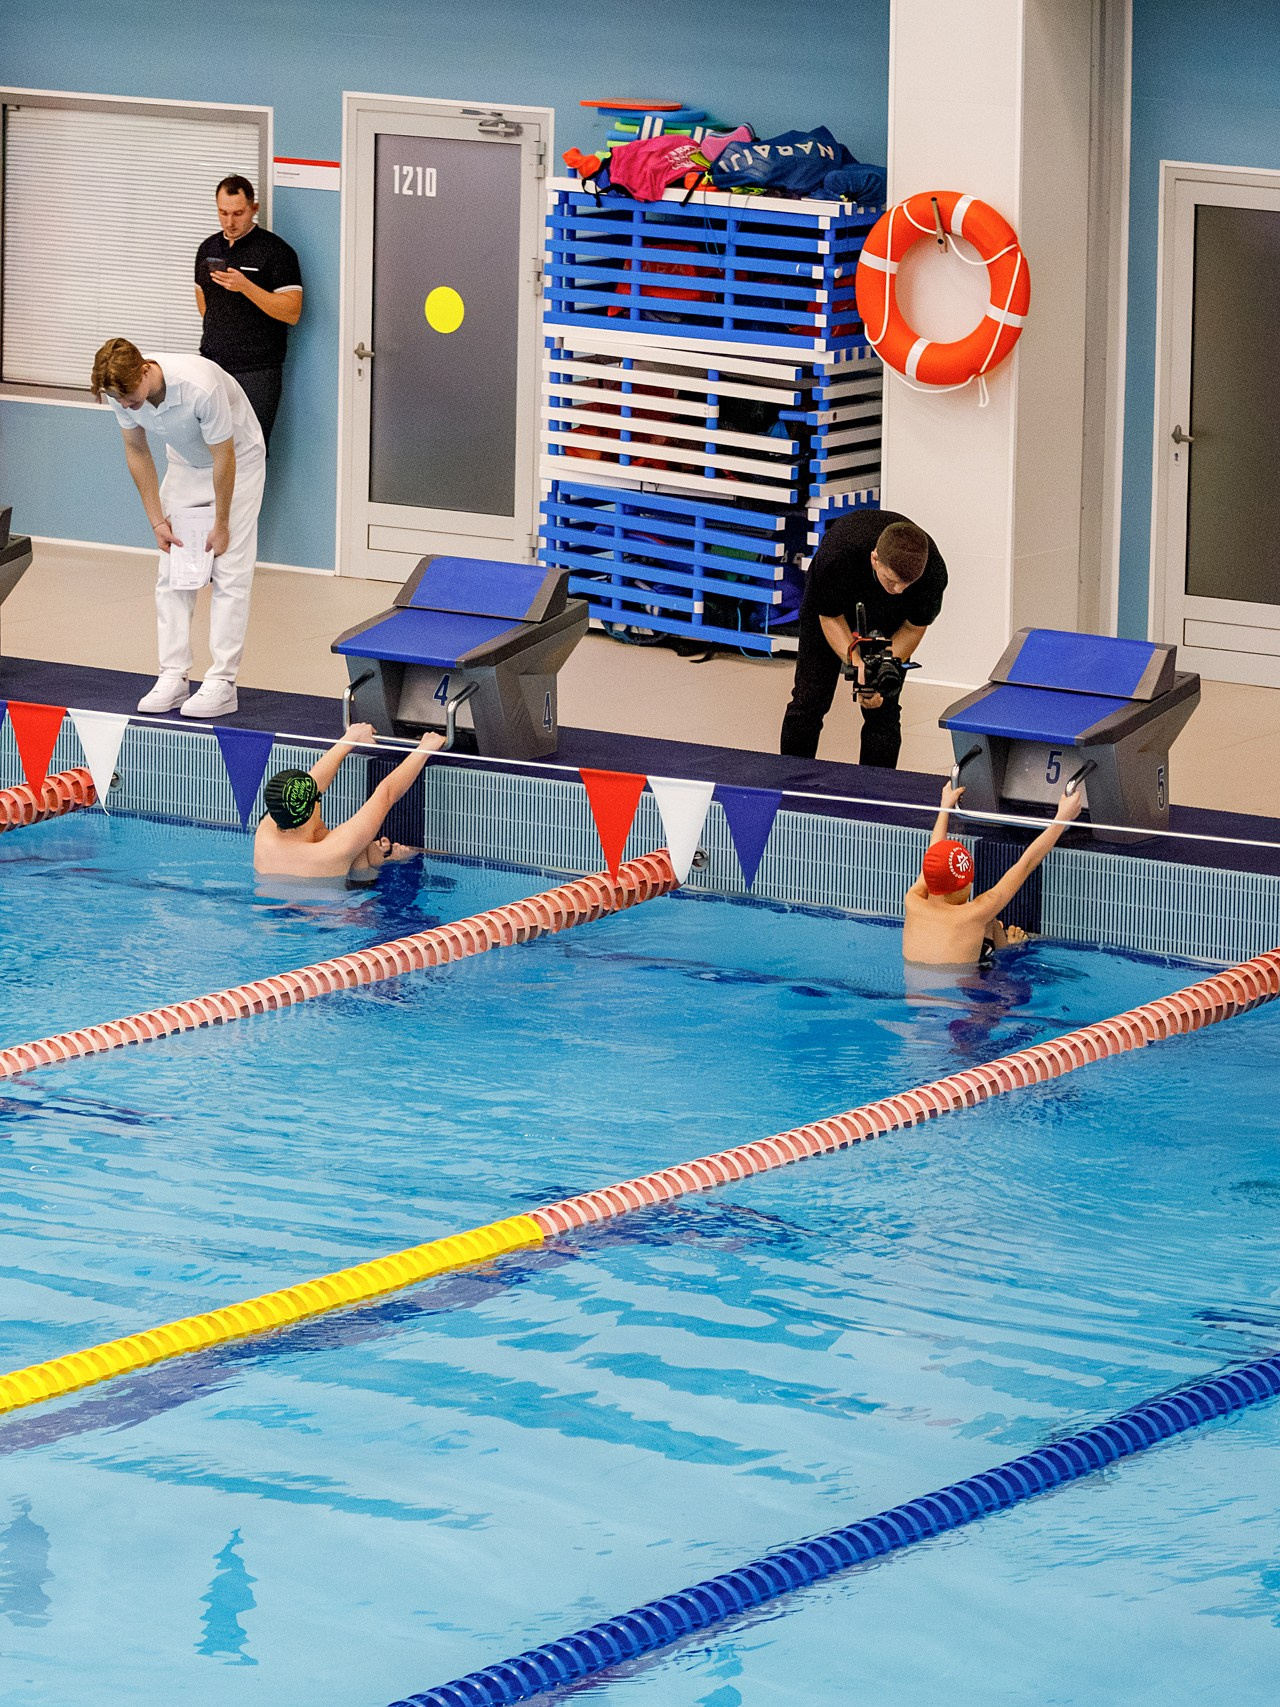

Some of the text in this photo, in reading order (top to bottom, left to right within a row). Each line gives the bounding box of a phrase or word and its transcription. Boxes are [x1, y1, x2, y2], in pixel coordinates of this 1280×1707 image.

[393, 164, 437, 197] 1210
[433, 673, 451, 706] 4
[543, 691, 553, 733] 4
[1045, 750, 1062, 785] 5
[1157, 765, 1165, 811] 5
